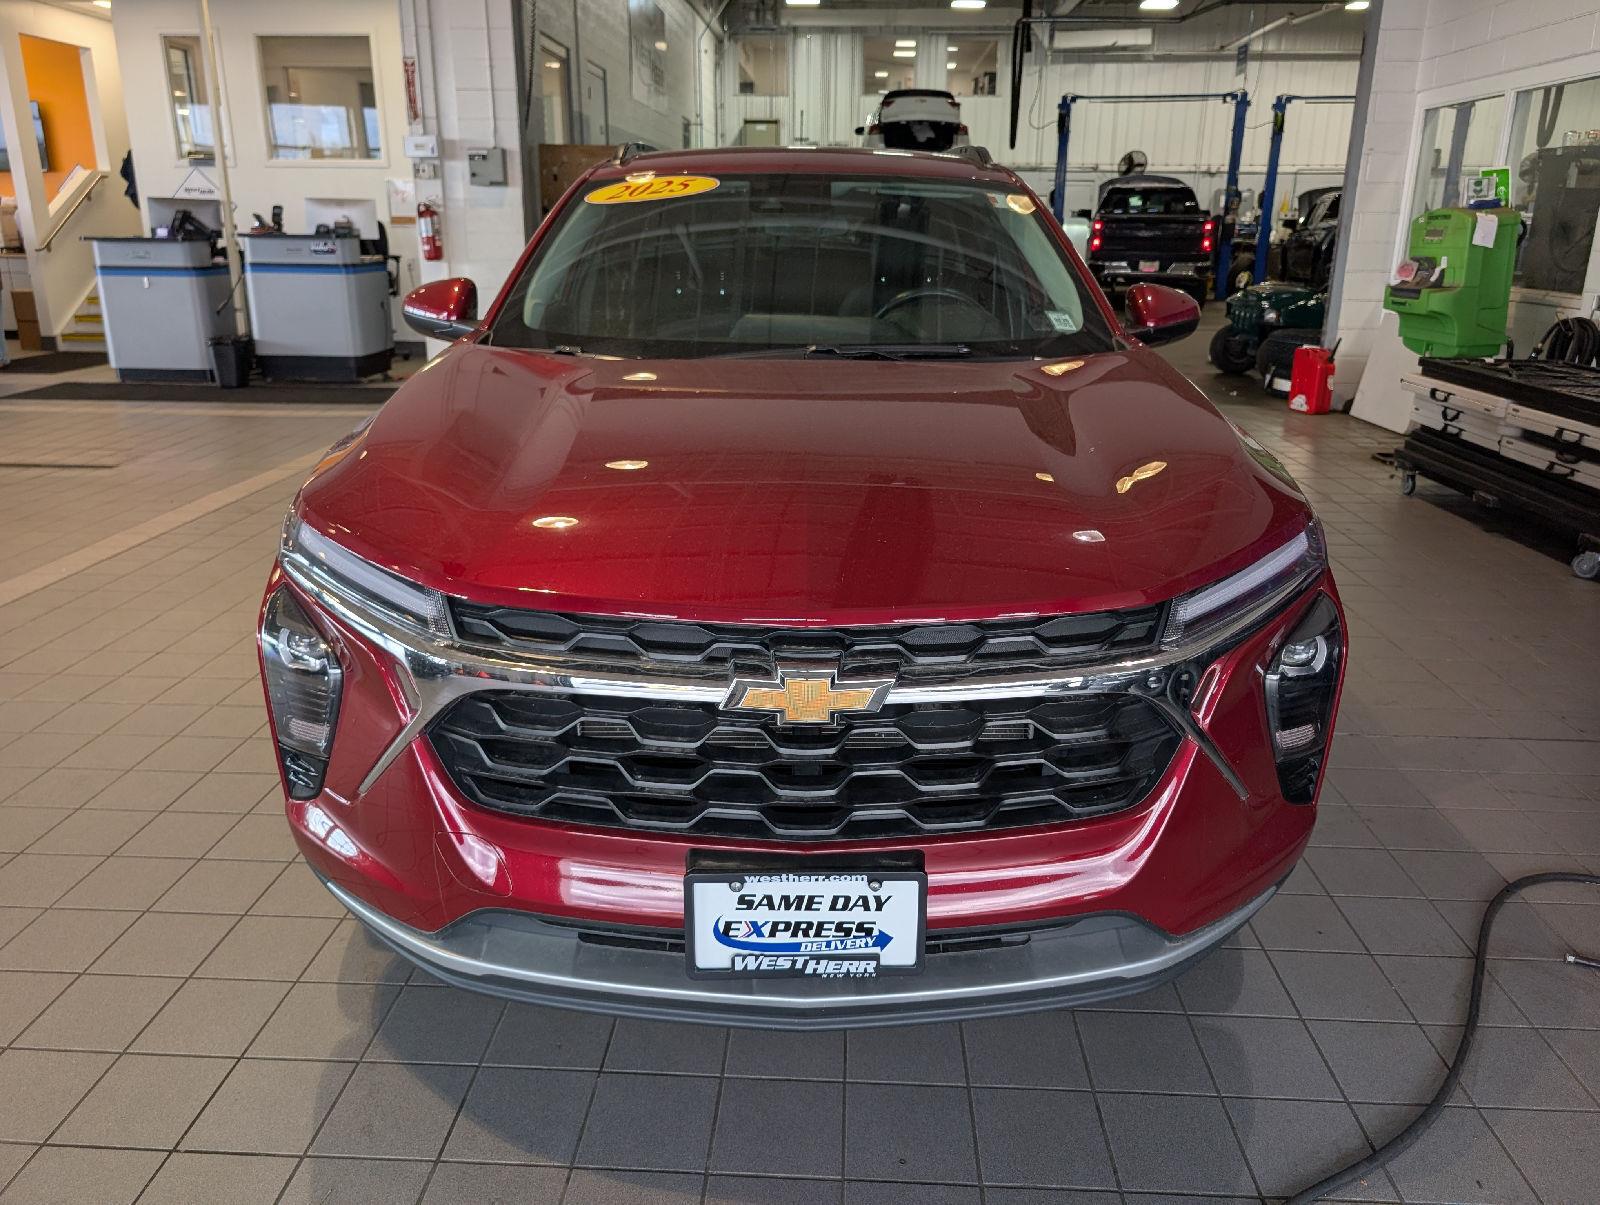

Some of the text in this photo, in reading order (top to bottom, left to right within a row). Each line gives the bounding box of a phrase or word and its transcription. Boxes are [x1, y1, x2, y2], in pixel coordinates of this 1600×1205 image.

[605, 179, 697, 200] 2025
[744, 873, 868, 883] westherr.com
[735, 894, 893, 912] SAME DAY
[722, 920, 877, 939] EXPRESS
[800, 936, 875, 952] DELIVERY
